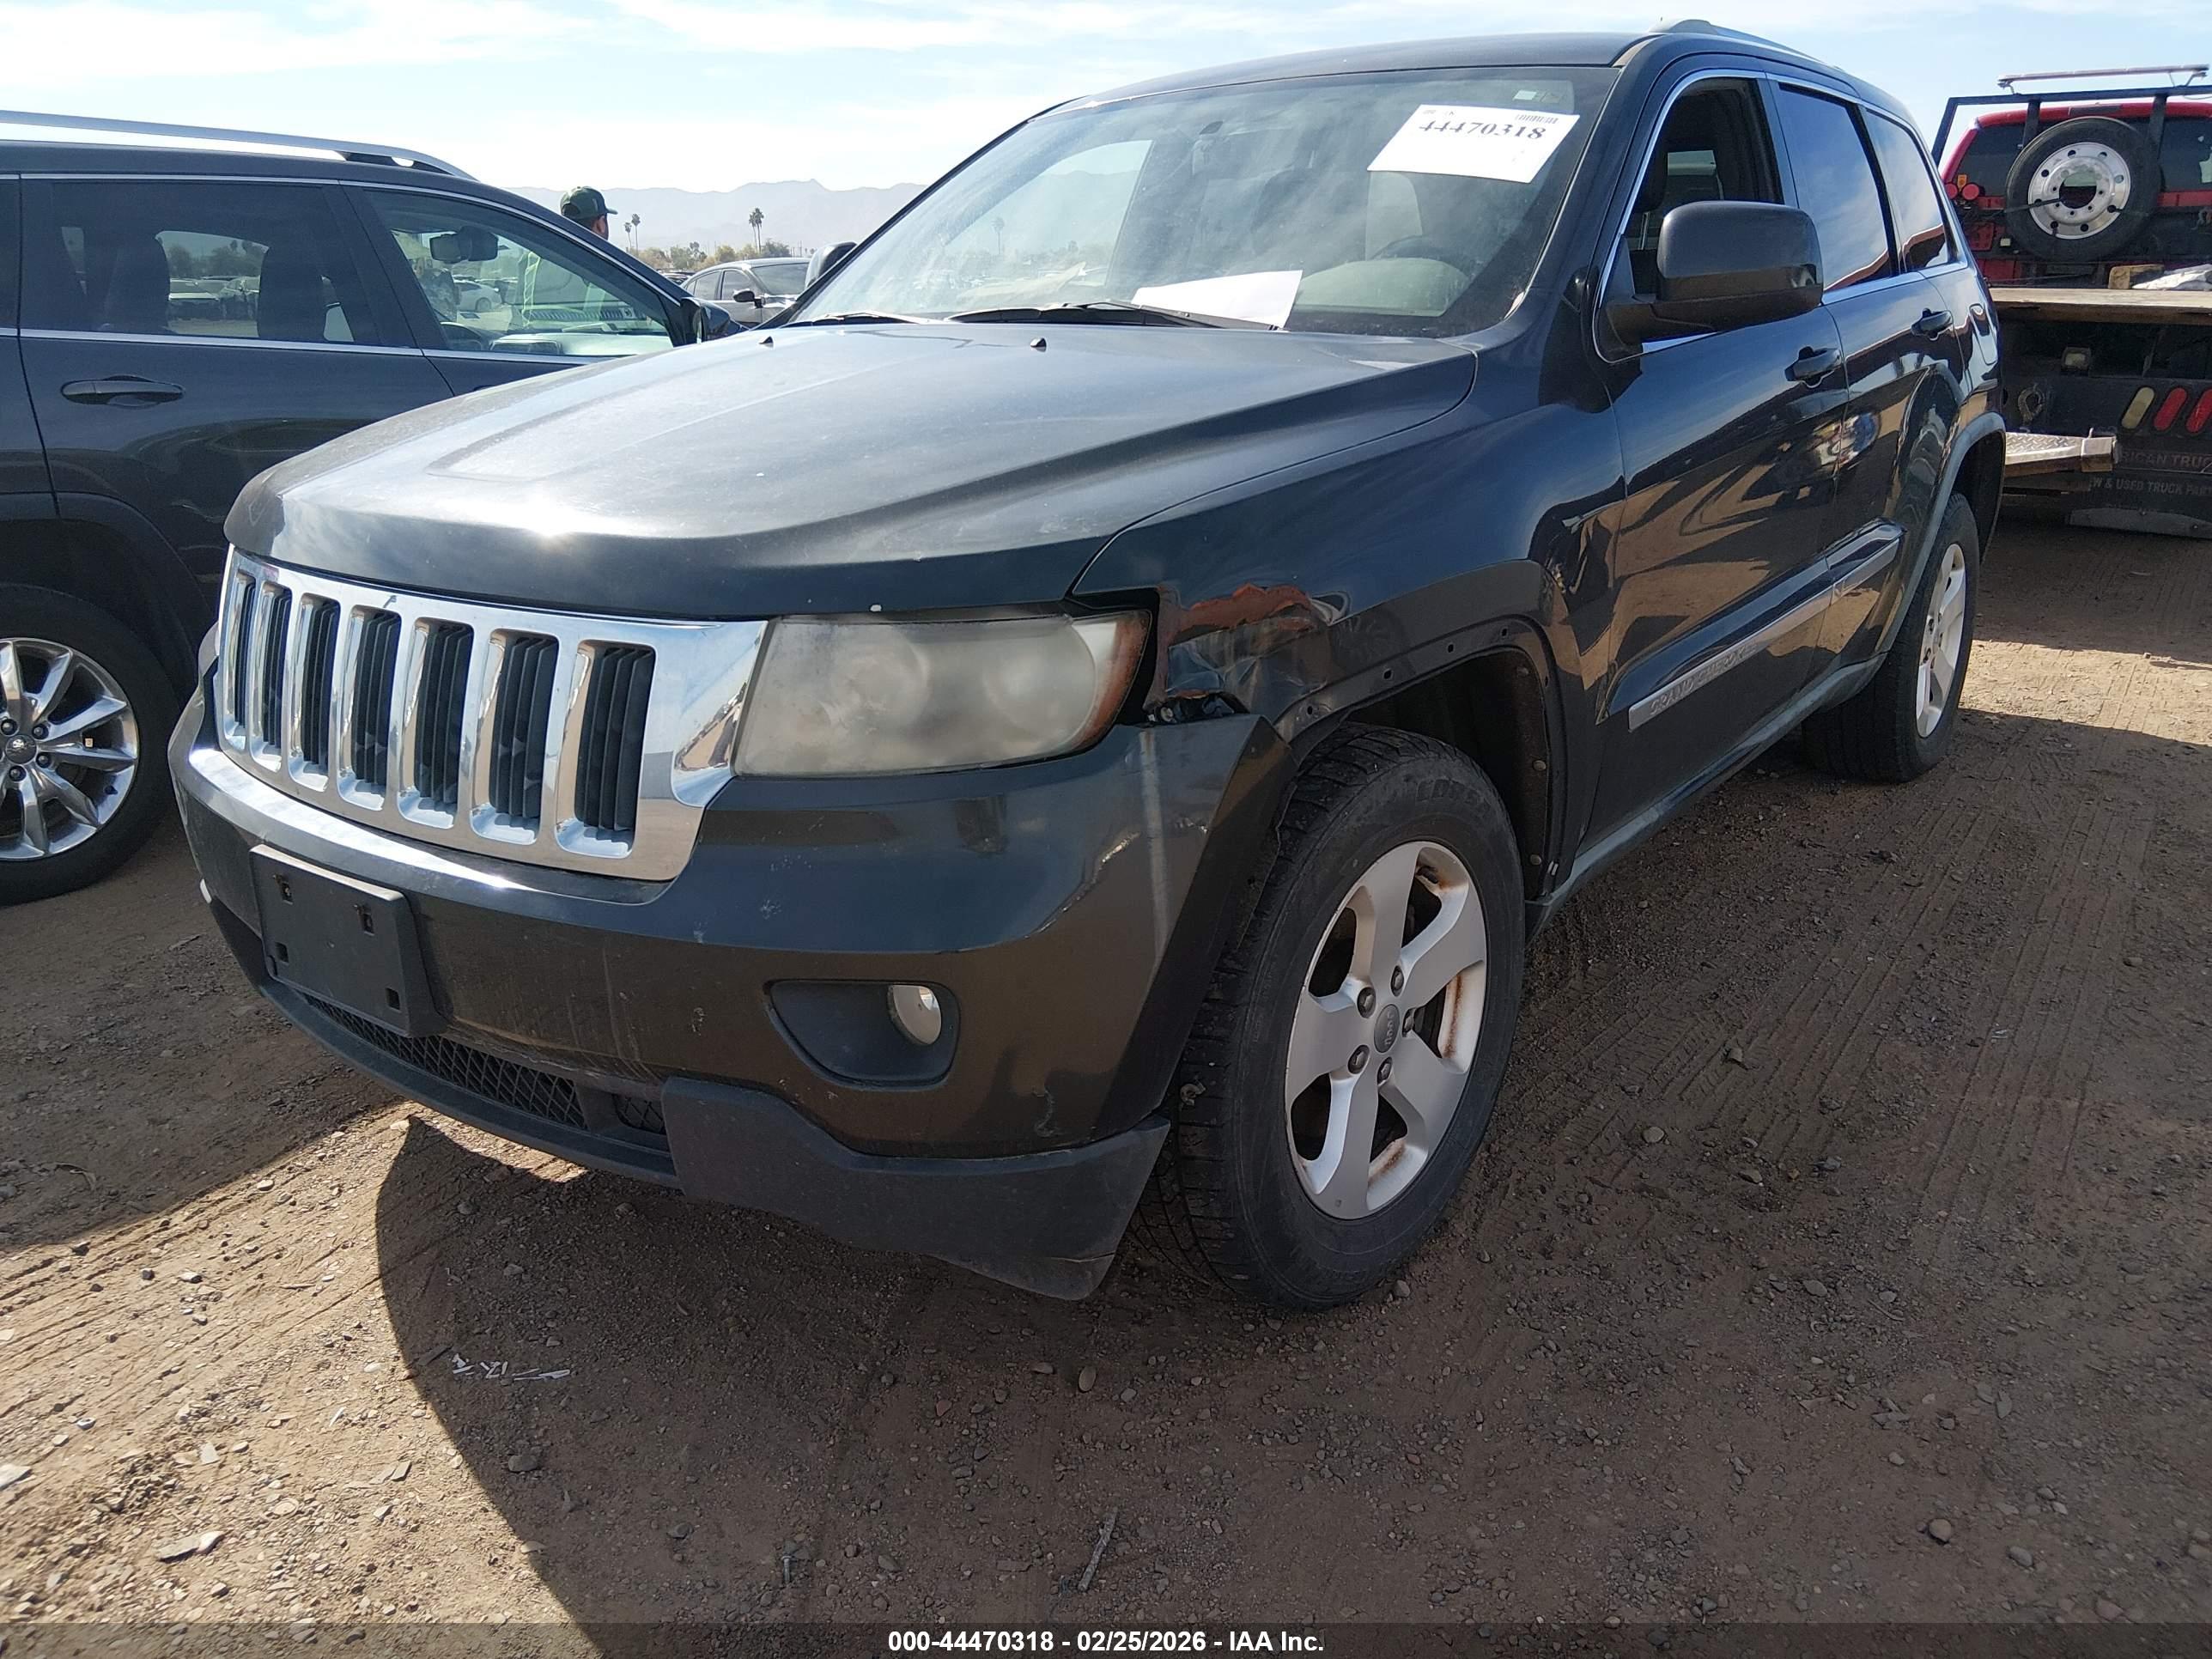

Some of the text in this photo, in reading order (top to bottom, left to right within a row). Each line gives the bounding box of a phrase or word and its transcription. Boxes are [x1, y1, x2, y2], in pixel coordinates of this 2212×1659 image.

[1419, 120, 1547, 140] 44470318
[2115, 477, 2144, 490] USED
[2147, 481, 2183, 495] TRUCK
[1649, 677, 1695, 716] GRAND
